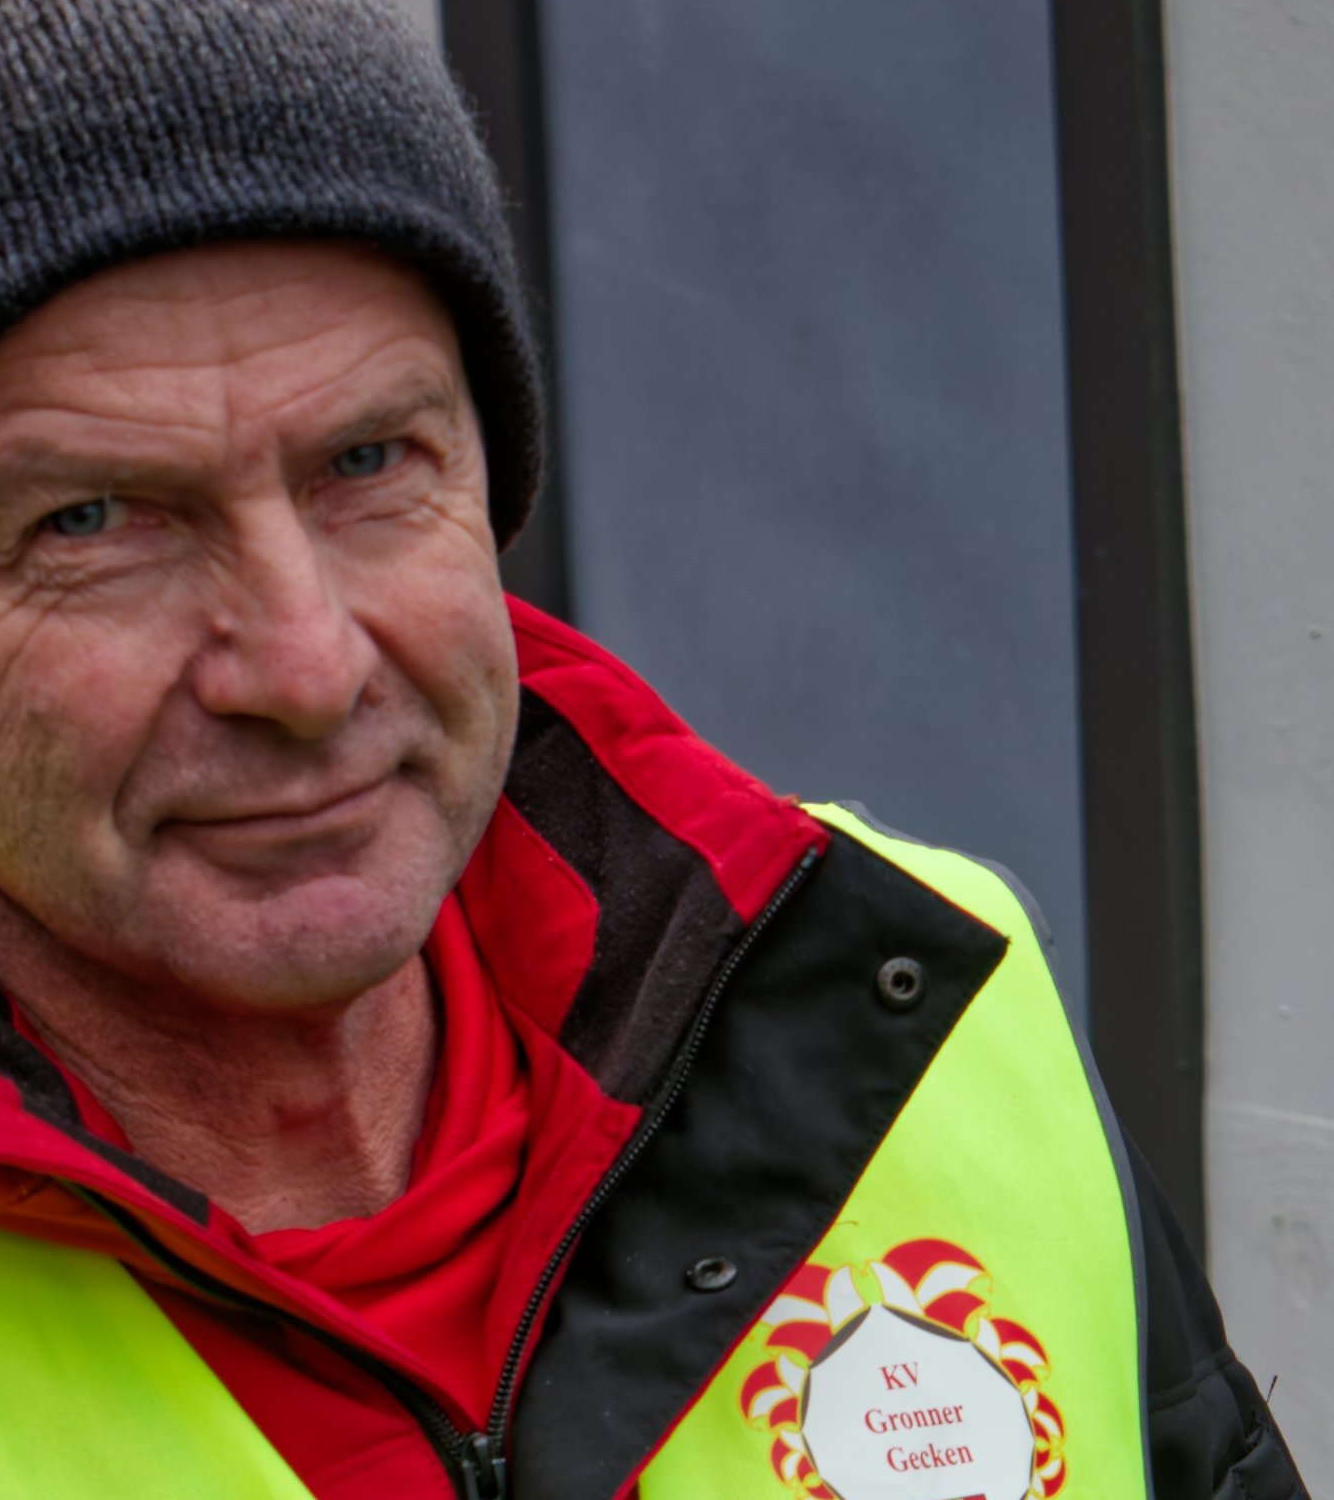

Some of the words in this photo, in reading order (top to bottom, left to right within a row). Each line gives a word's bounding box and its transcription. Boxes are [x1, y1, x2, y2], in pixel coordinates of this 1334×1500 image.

[879, 1361, 918, 1391] KV
[864, 1404, 964, 1434] Gronner
[886, 1442, 974, 1472] Gecken
